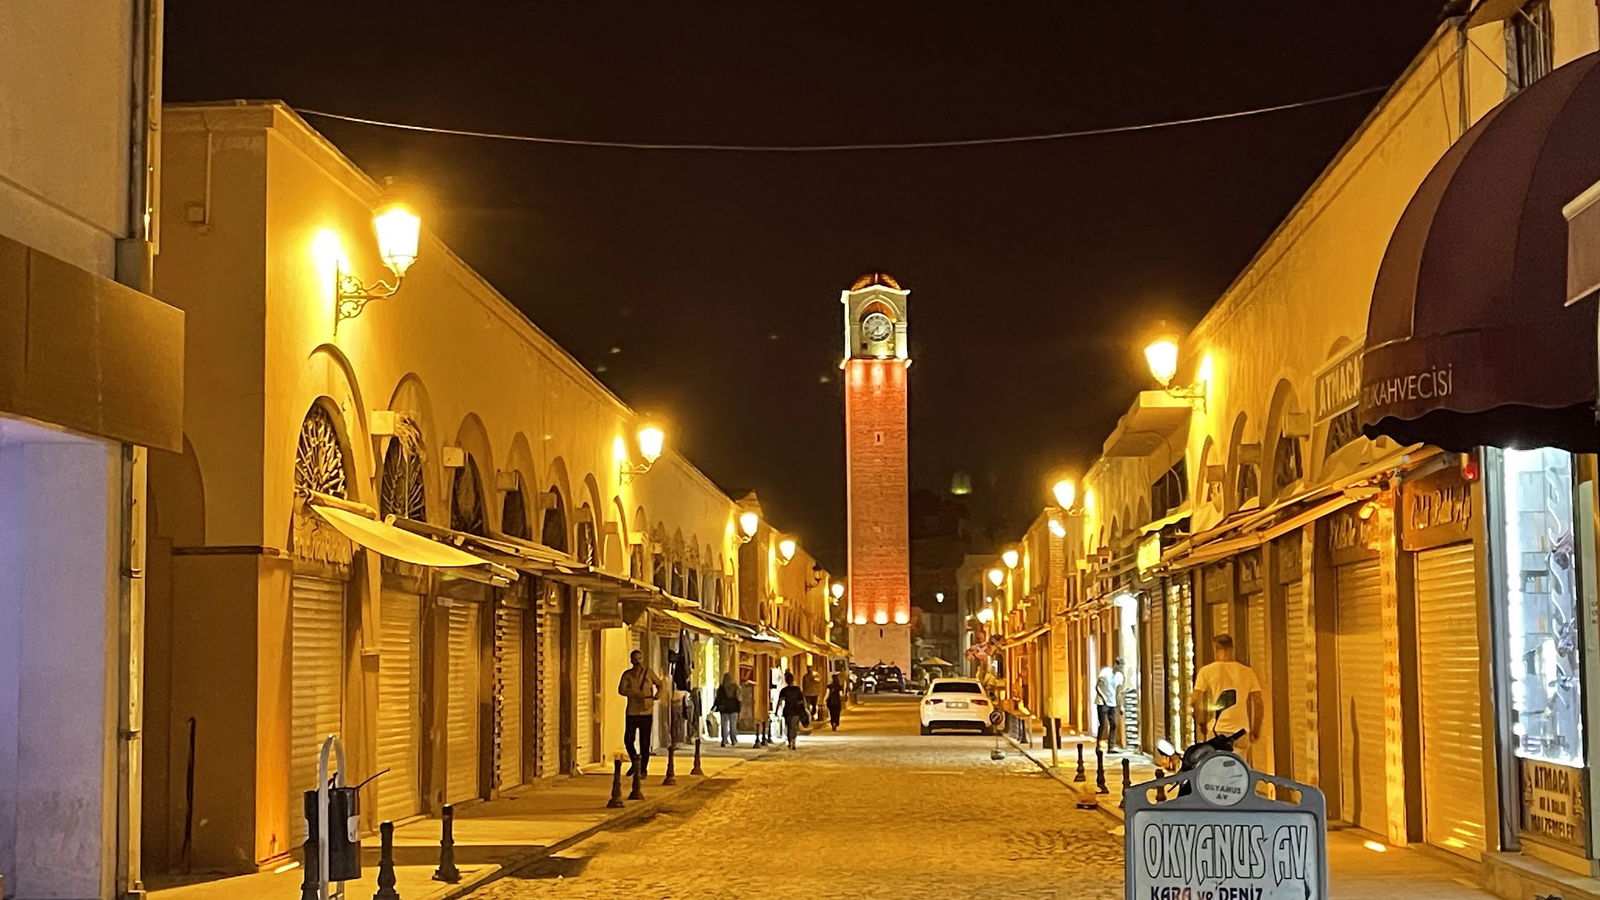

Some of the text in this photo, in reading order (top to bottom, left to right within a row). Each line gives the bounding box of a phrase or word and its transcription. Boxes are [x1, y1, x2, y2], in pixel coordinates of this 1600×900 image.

[1318, 355, 1362, 417] ATMACA
[1204, 783, 1241, 794] OKYANUS
[1534, 766, 1570, 795] ATMACA
[1143, 823, 1308, 887] OKYANUS AV
[1150, 883, 1262, 900] KARA ve DENİZ
